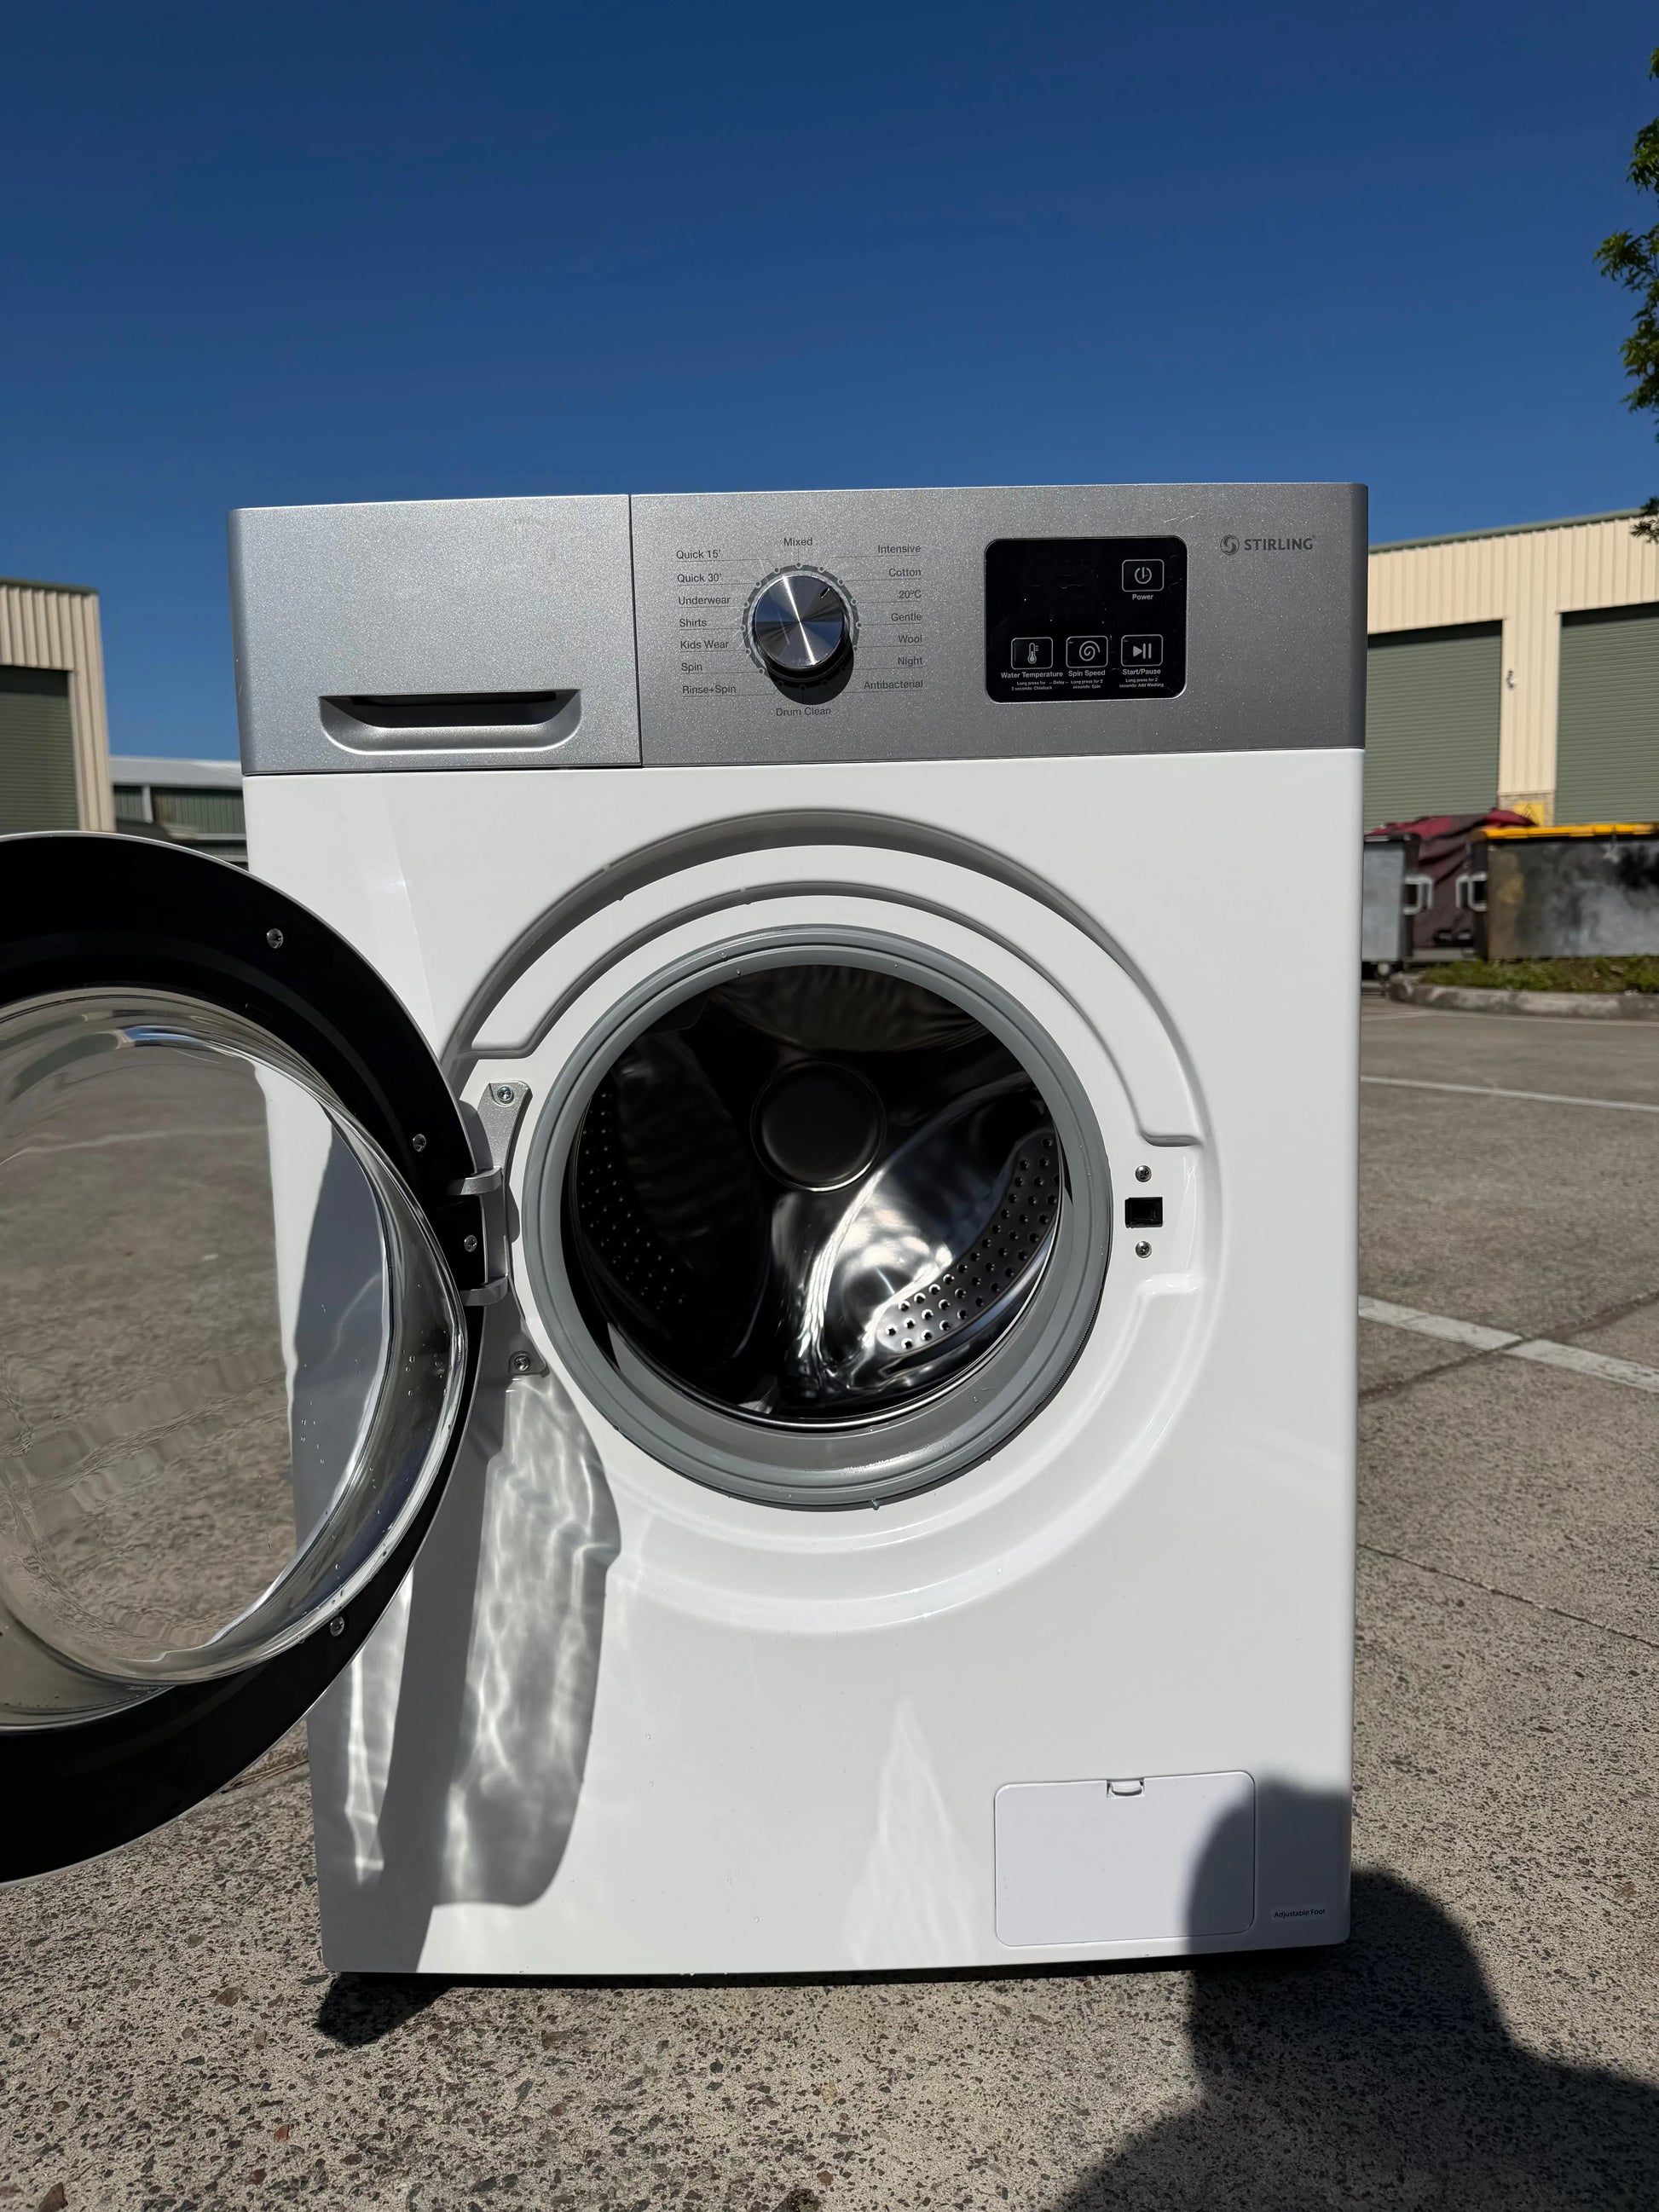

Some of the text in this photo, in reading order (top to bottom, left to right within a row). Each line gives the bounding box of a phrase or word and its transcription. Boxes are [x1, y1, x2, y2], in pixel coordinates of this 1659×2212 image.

[783, 537, 812, 546] Mixed
[1244, 538, 1313, 551] STIRLING
[877, 544, 922, 554] Intensive
[676, 550, 704, 559] Quick
[888, 568, 922, 577] Cotton
[677, 574, 705, 583] Quick
[678, 596, 731, 605] Underwear
[891, 612, 922, 621] Gentle
[679, 618, 707, 627] Shirts
[898, 634, 922, 644] Wool
[680, 639, 730, 649] Kids Wear
[898, 656, 922, 667] Night
[681, 662, 702, 673] Spin
[1021, 671, 1064, 679] Temperature
[1084, 669, 1106, 678] Speed
[864, 679, 923, 690] Antibacterial
[682, 684, 737, 695] Rinse+Spin
[776, 707, 831, 716] Drum Clean
[1274, 1909, 1310, 1919] Adjustable
